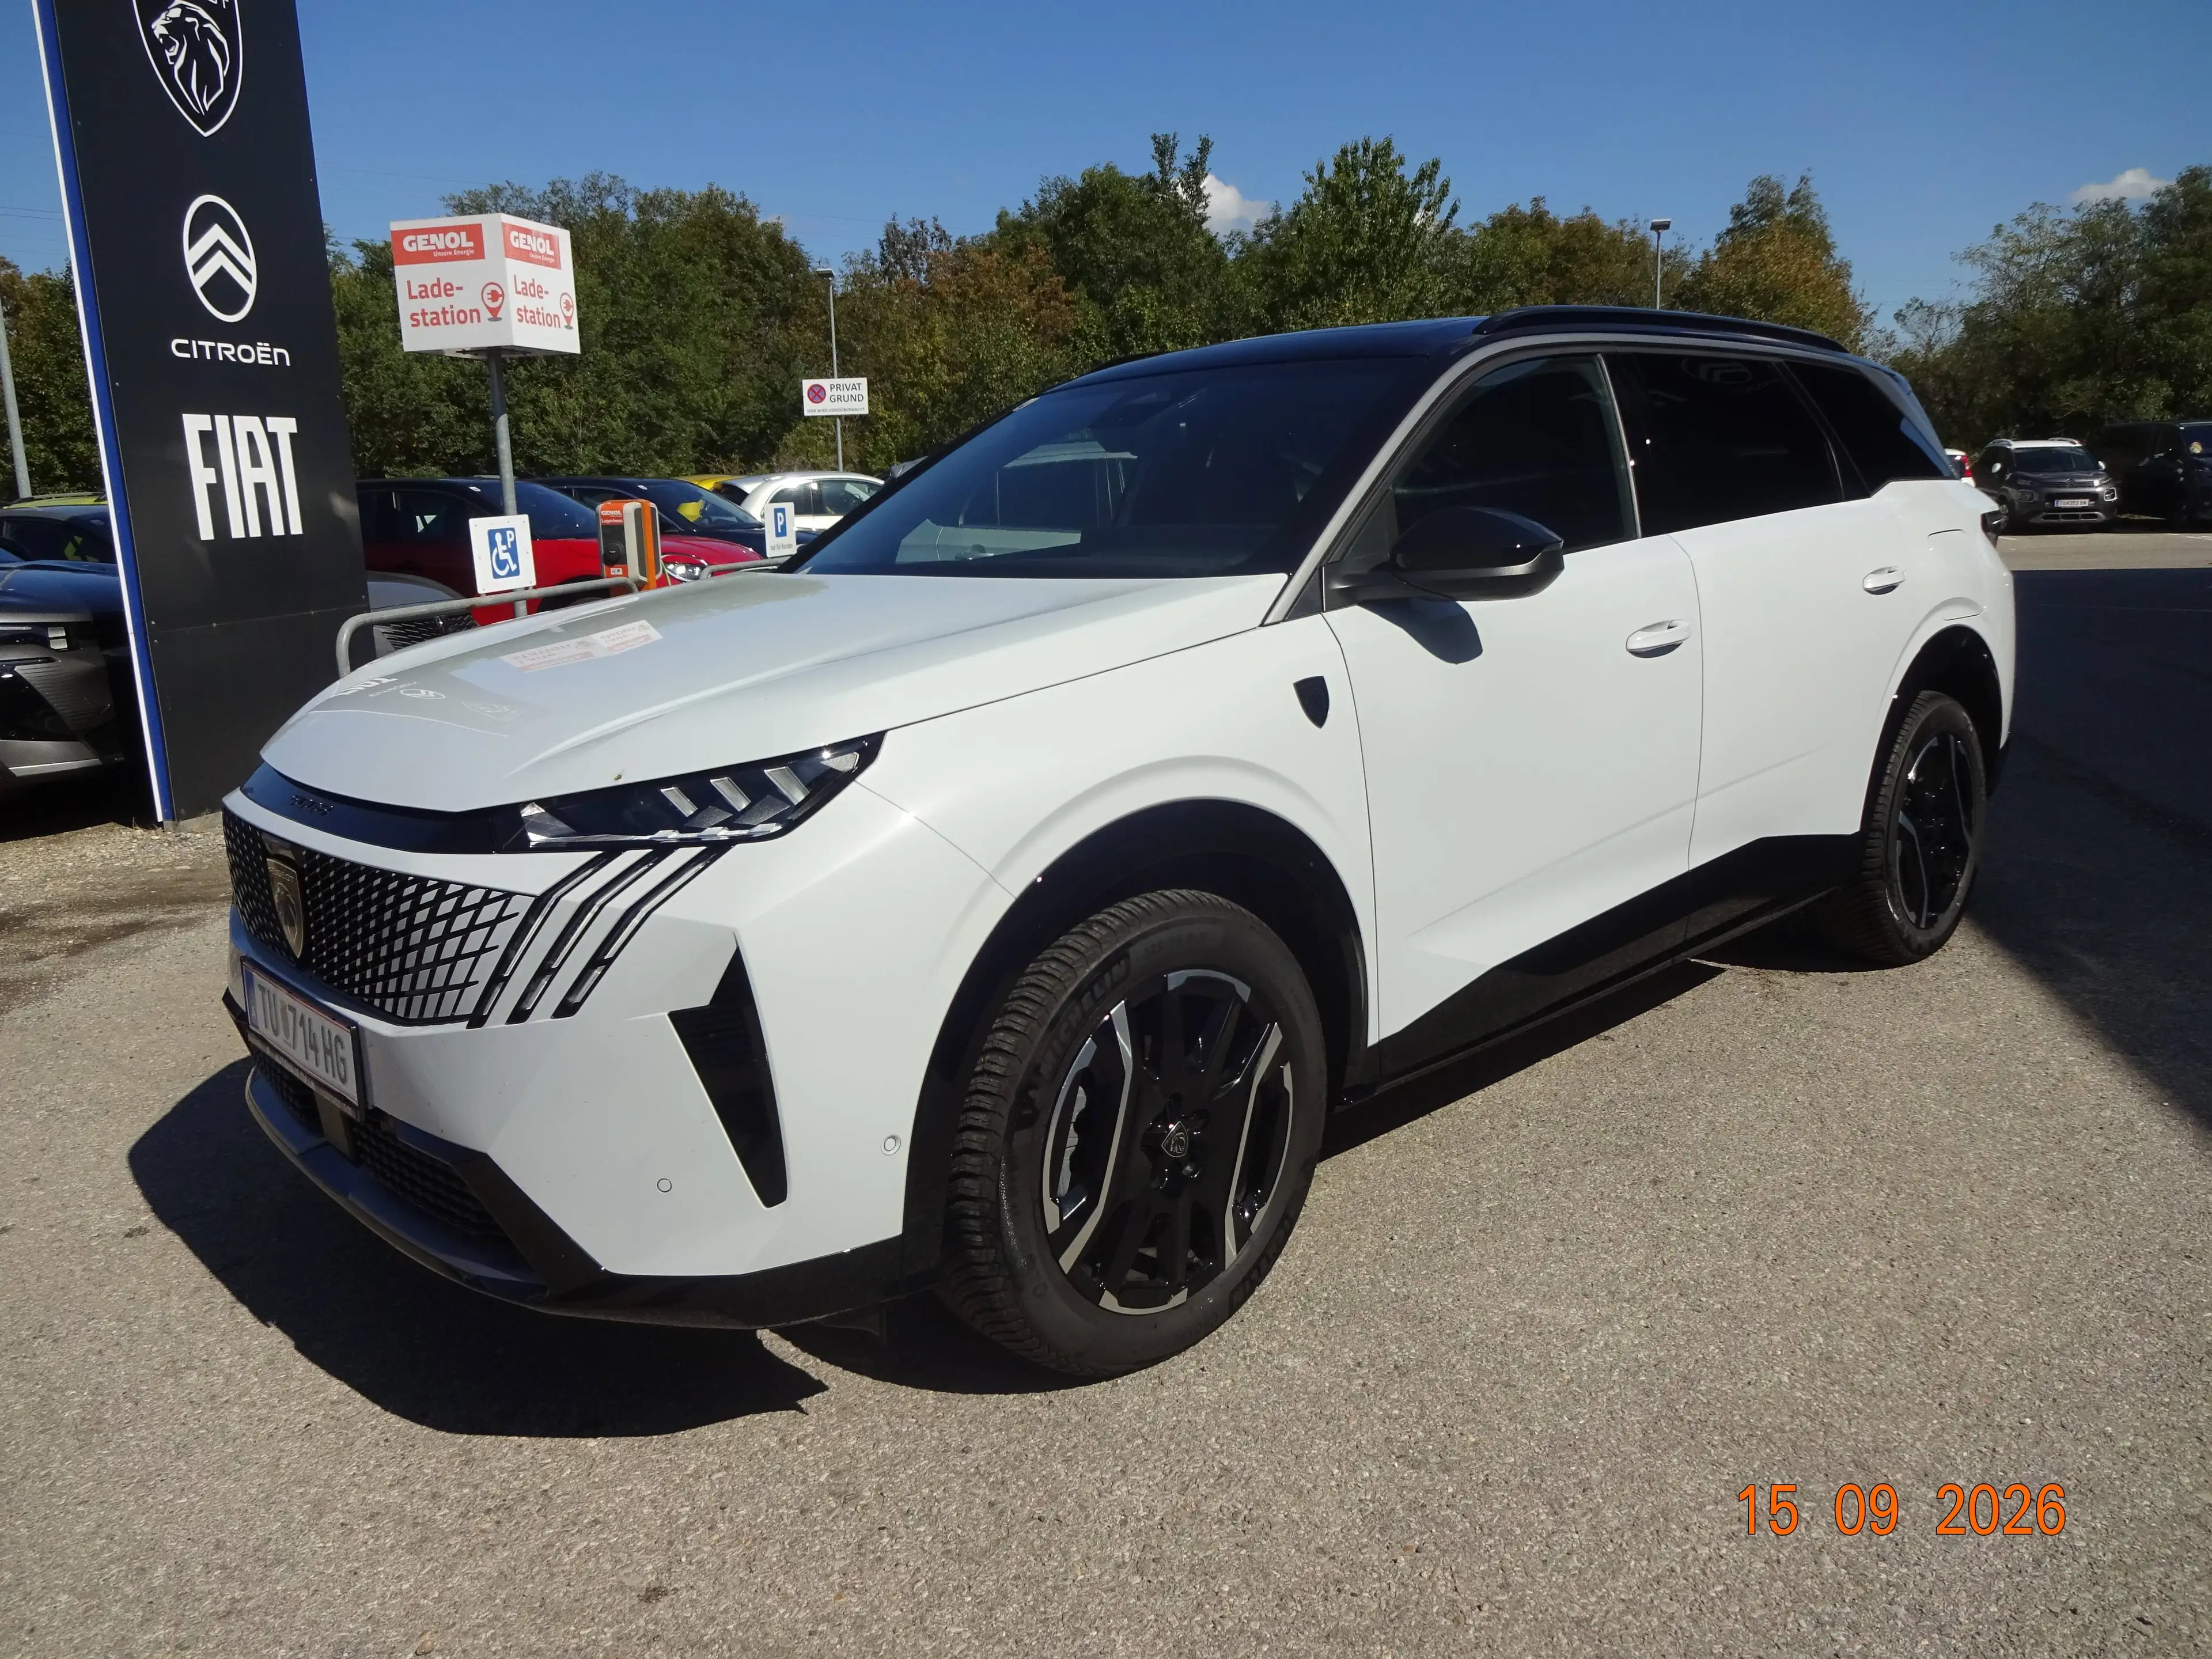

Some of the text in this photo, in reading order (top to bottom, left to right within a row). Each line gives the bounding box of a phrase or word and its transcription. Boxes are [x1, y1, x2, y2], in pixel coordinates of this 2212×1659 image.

[403, 232, 474, 252] GENOL
[510, 230, 554, 256] GENOL
[406, 277, 463, 300] Lade-
[513, 274, 549, 299] Lade-
[410, 305, 482, 327] station
[517, 305, 561, 329] station
[830, 382, 862, 392] PRIVAT
[830, 394, 864, 403] GRUND
[182, 413, 304, 540] FIAT
[777, 512, 784, 533] P
[506, 530, 514, 548] P
[258, 983, 279, 1037] TU
[287, 1004, 320, 1068] 714
[320, 1025, 347, 1085] HG
